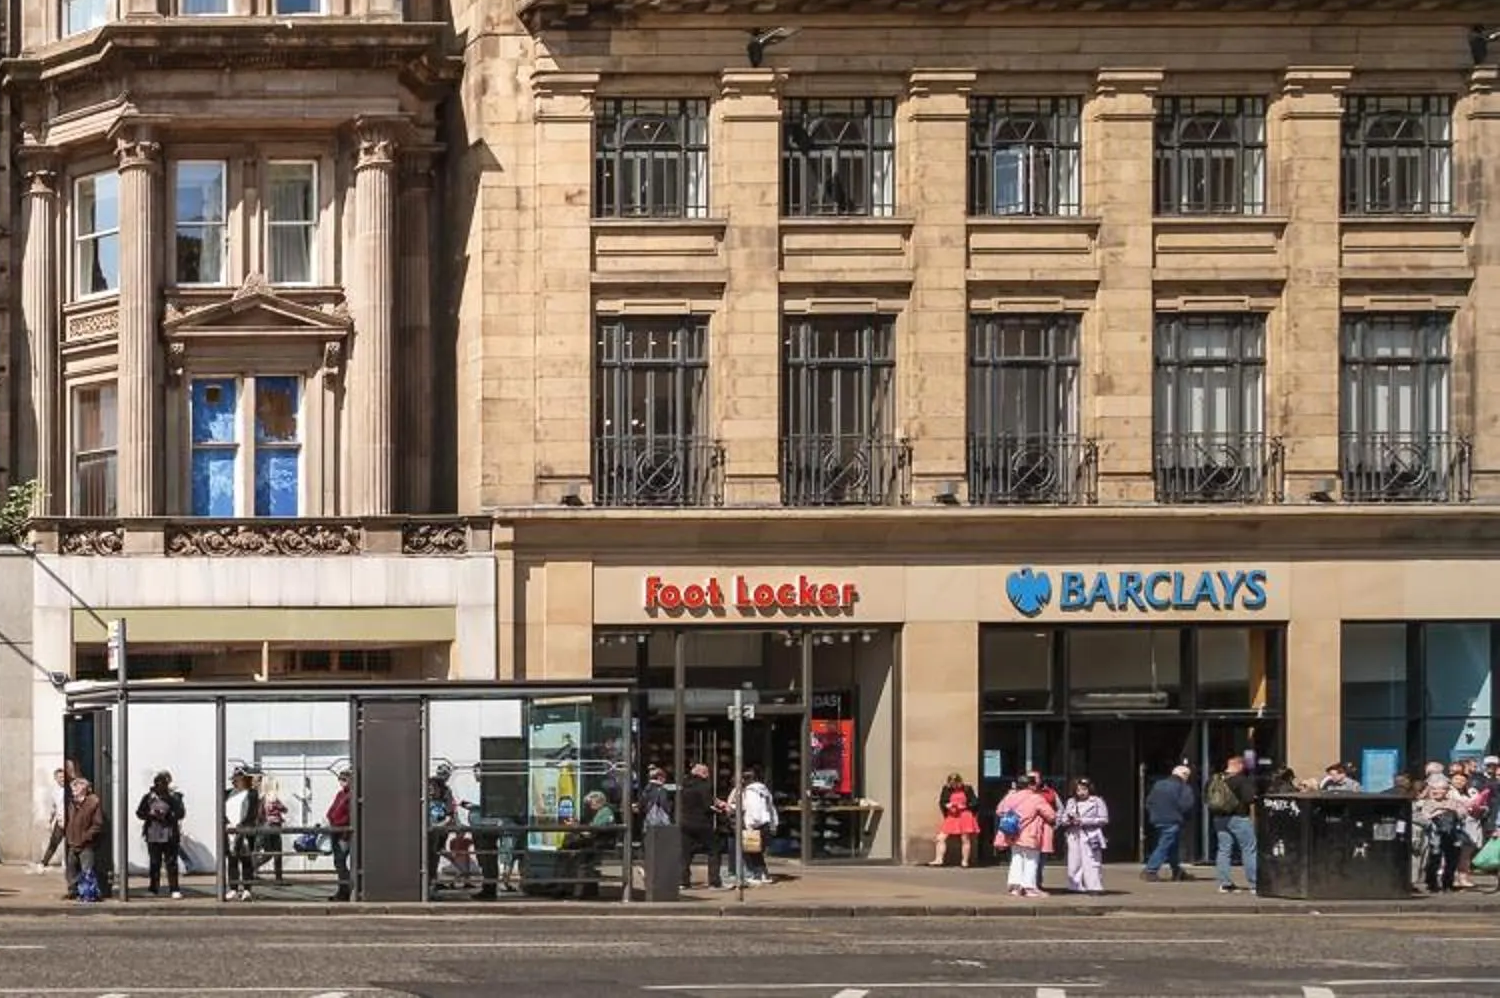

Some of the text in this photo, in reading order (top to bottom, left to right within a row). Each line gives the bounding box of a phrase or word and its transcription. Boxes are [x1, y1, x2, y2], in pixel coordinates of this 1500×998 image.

[644, 574, 858, 609] Foot Locker
[1060, 569, 1268, 612] BARCLAYS
